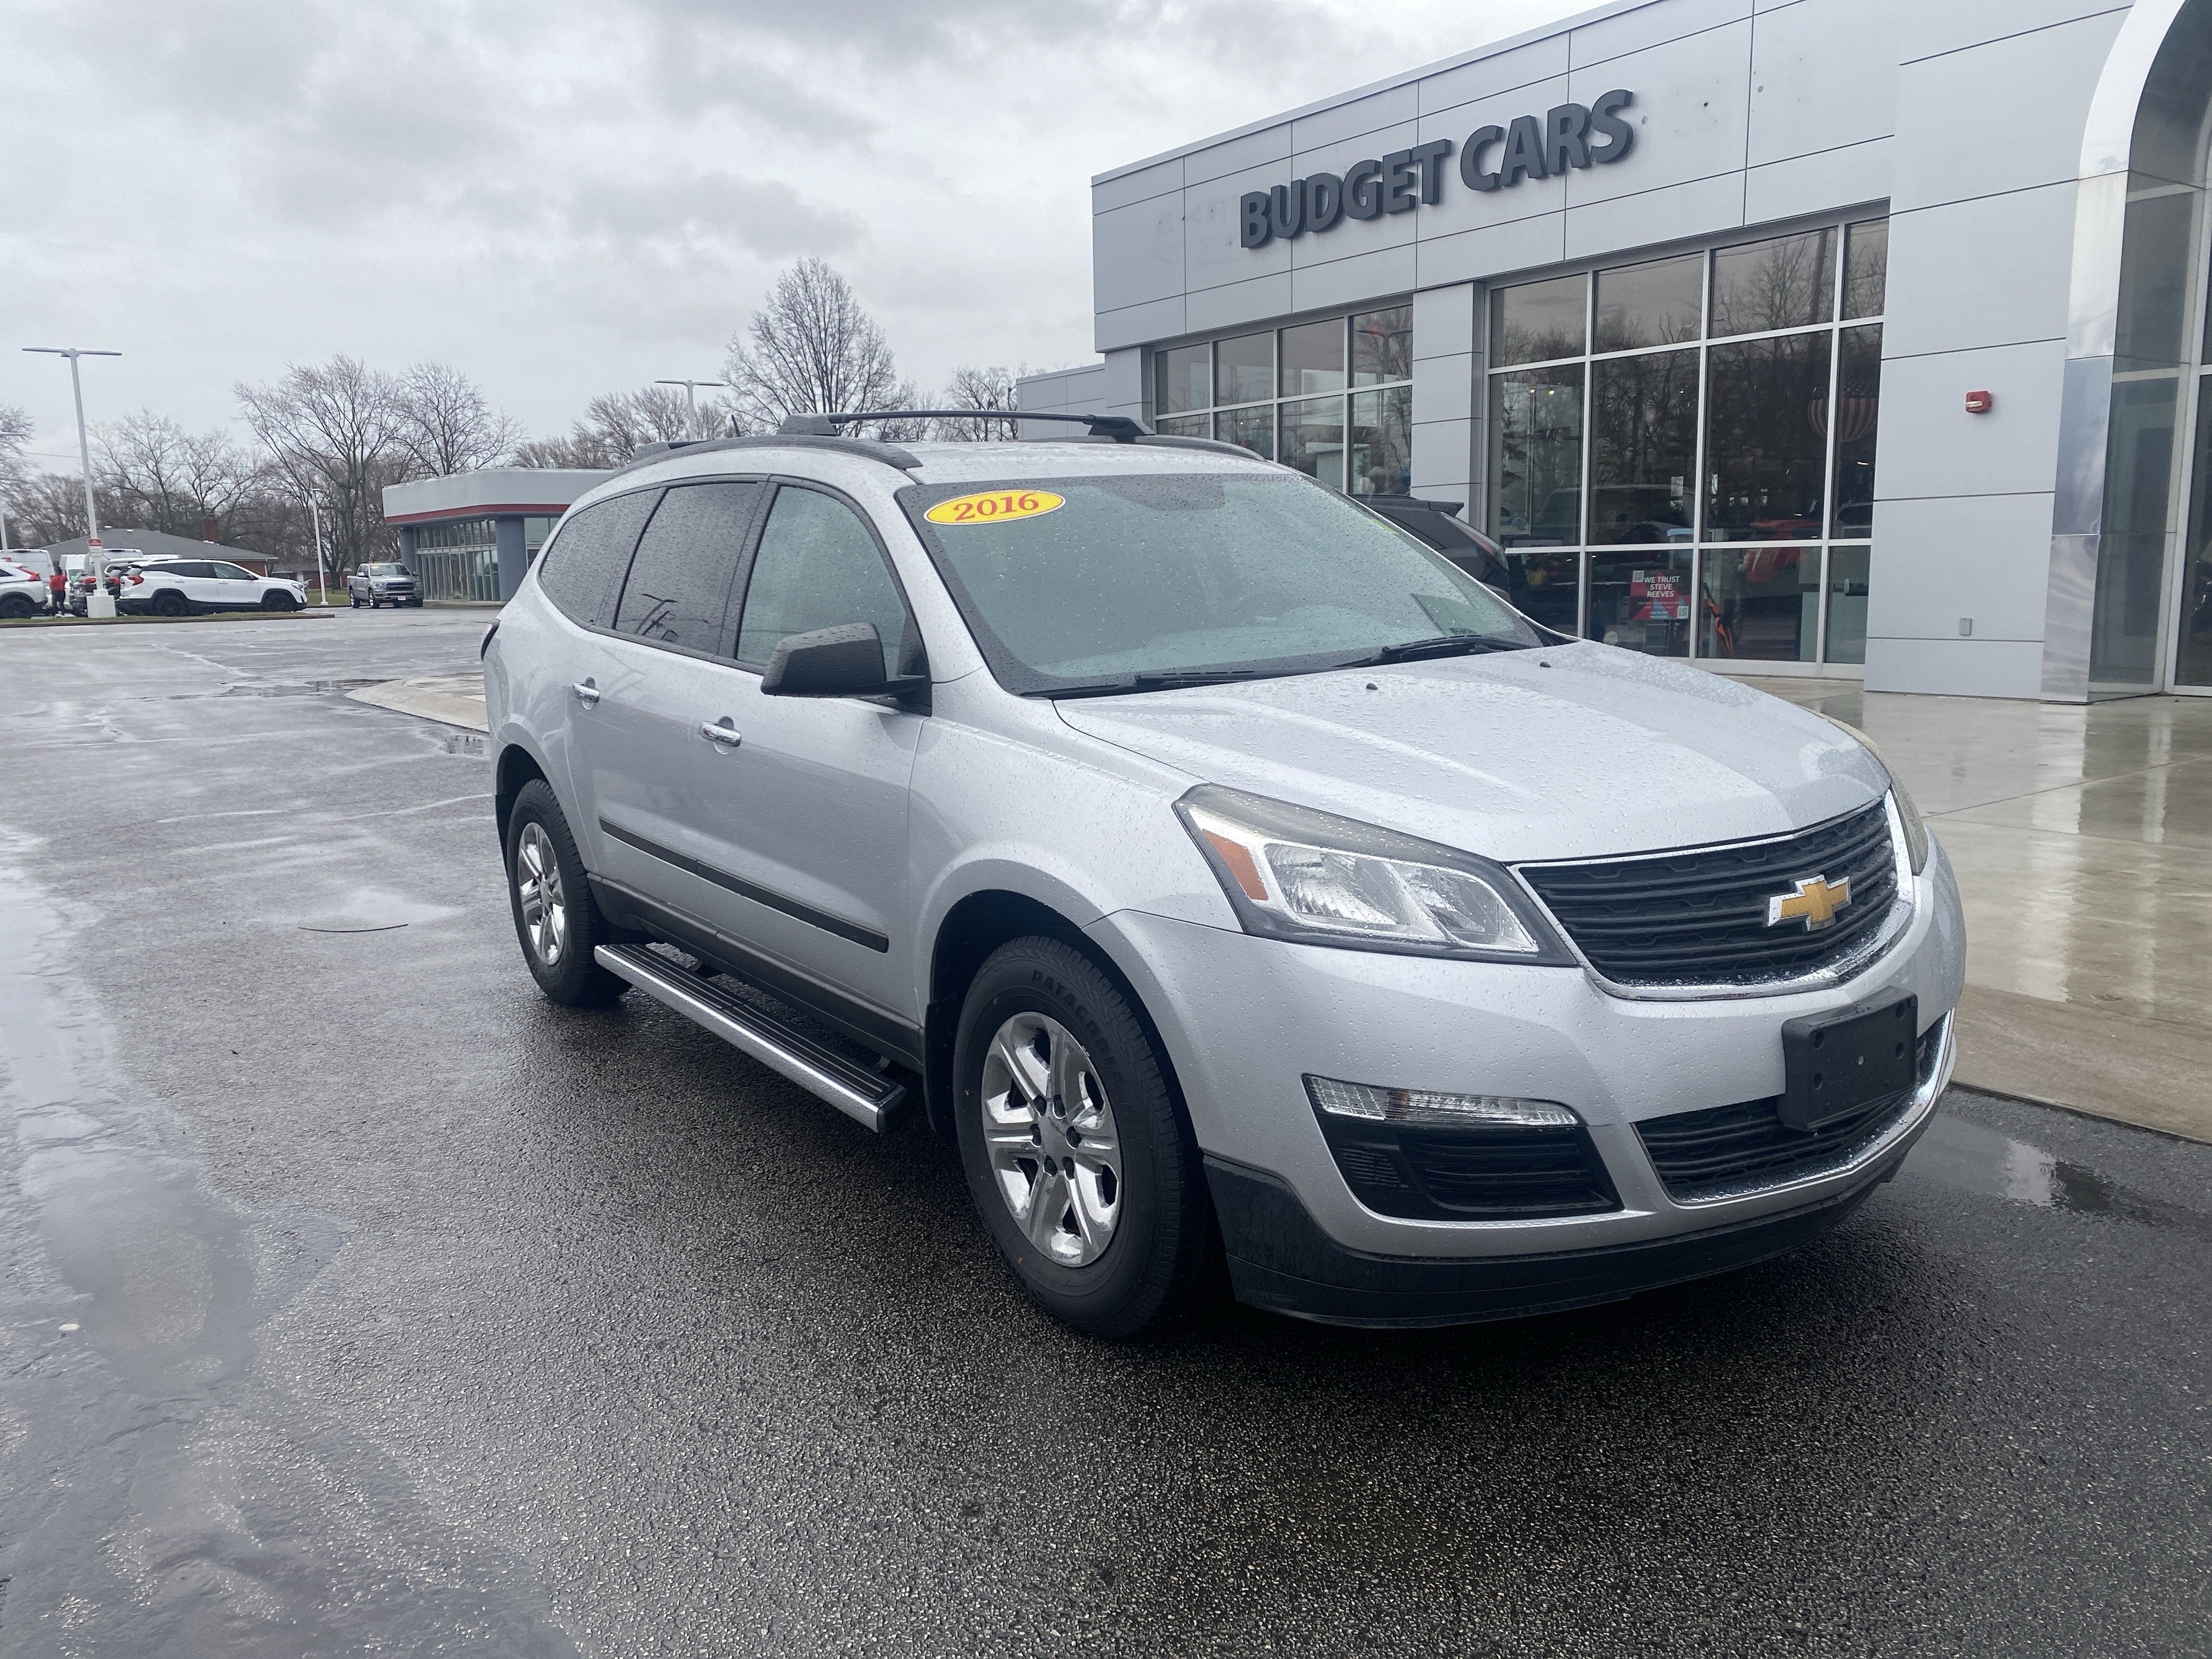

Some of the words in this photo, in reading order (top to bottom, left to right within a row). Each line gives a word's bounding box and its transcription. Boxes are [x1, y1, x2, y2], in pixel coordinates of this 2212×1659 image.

[1241, 138, 1452, 248] BUDGET
[1460, 89, 1634, 191] CARS
[953, 493, 1039, 521] 2016
[1032, 970, 1124, 1086] PATAGONIA
